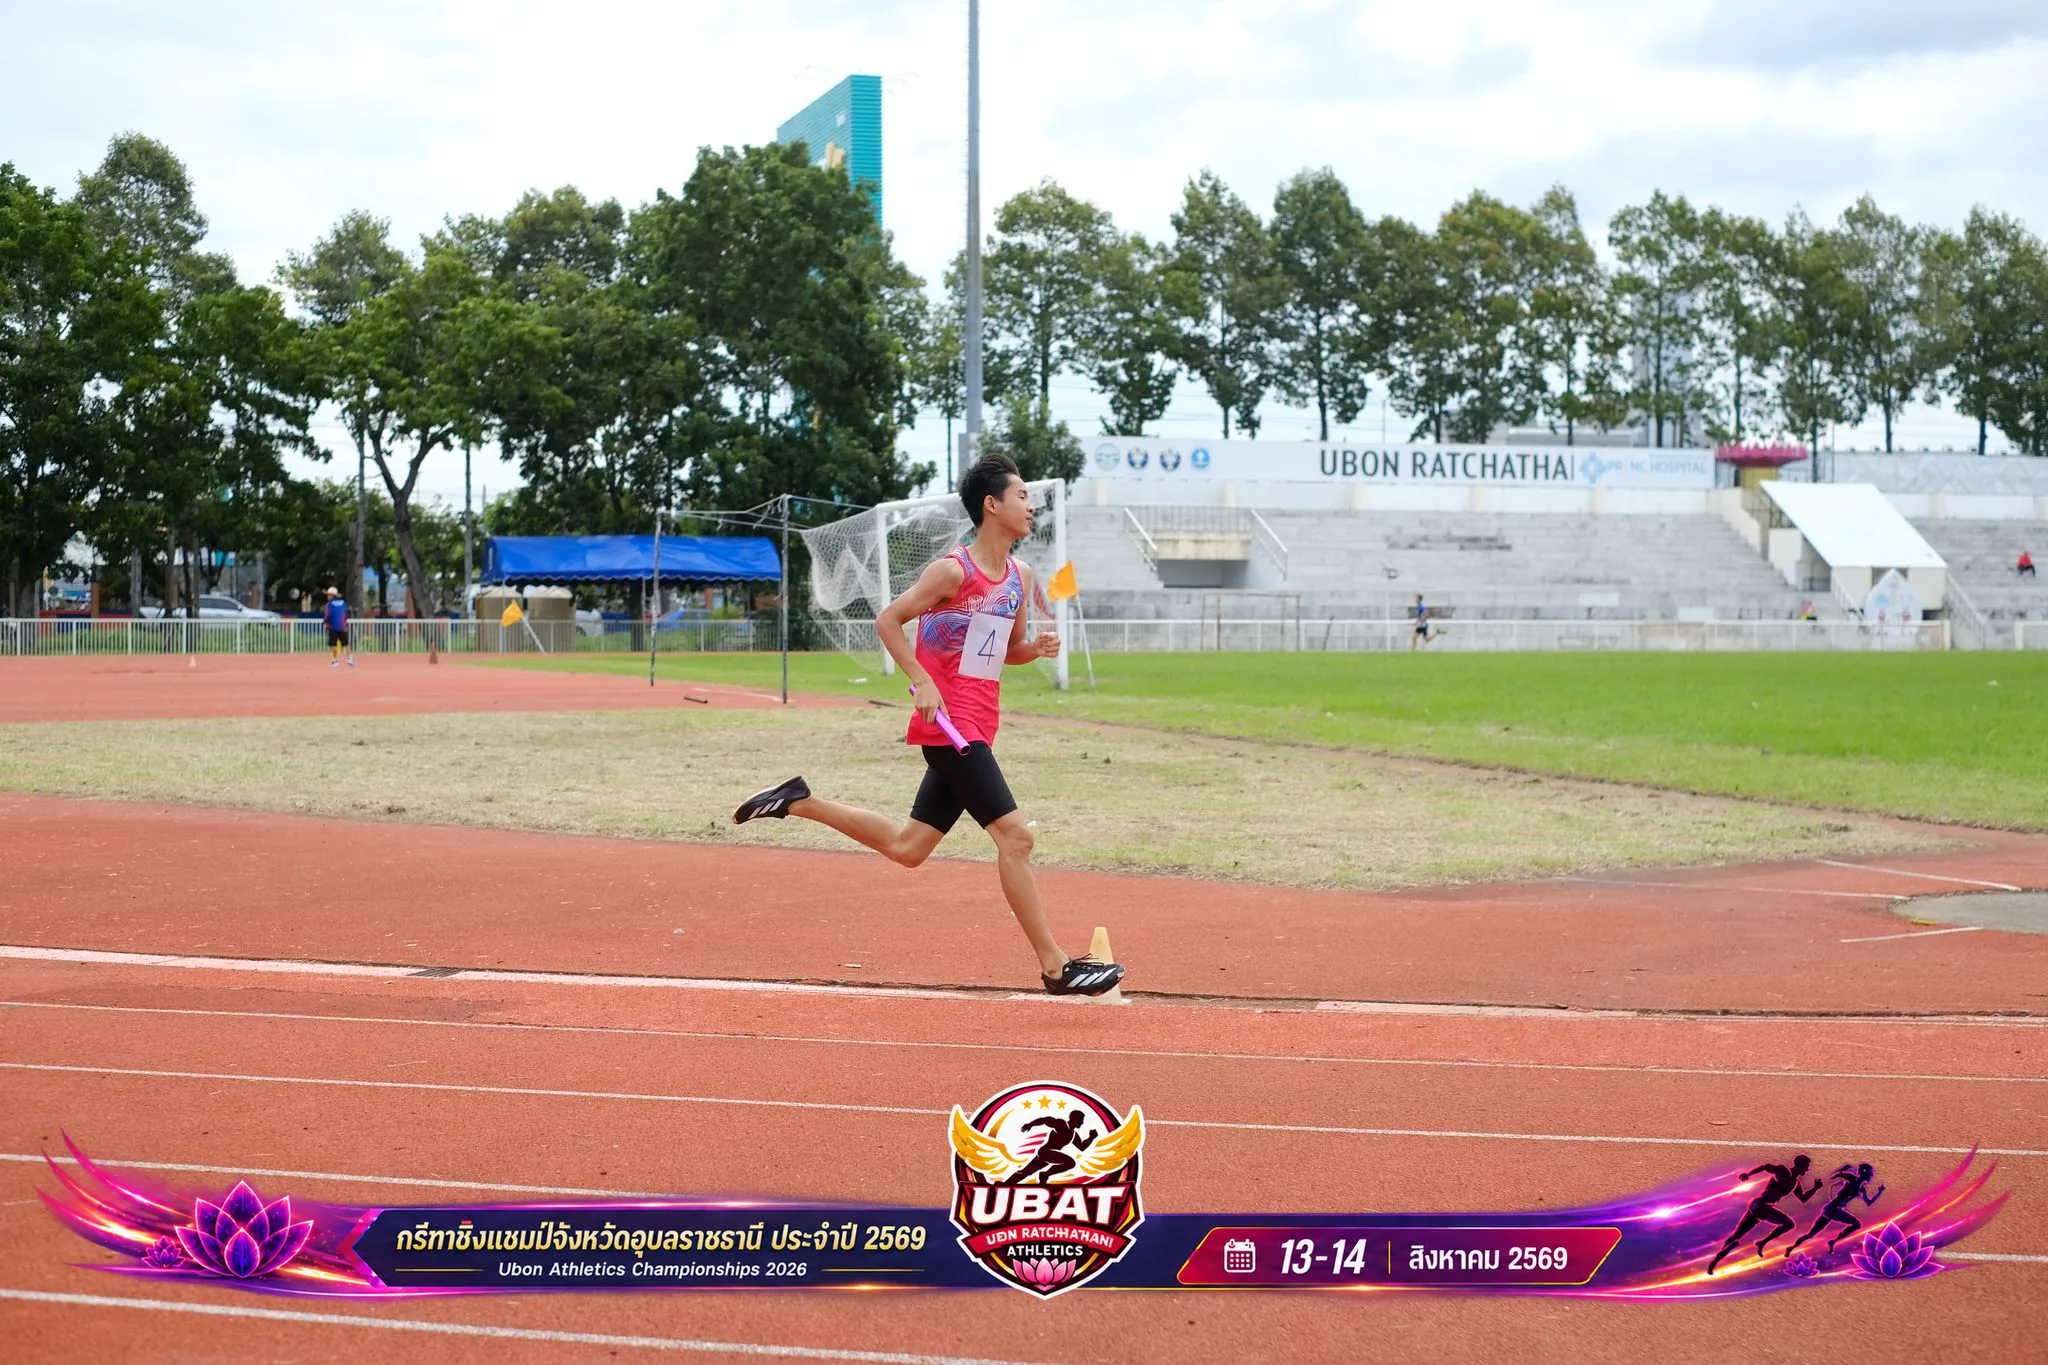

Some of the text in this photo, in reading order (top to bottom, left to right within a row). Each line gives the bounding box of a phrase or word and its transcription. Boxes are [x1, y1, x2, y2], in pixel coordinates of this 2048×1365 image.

[1321, 450, 1575, 480] UBON RATCHATHA
[1650, 459, 1707, 474] HOSPITAL
[977, 629, 996, 666] 4
